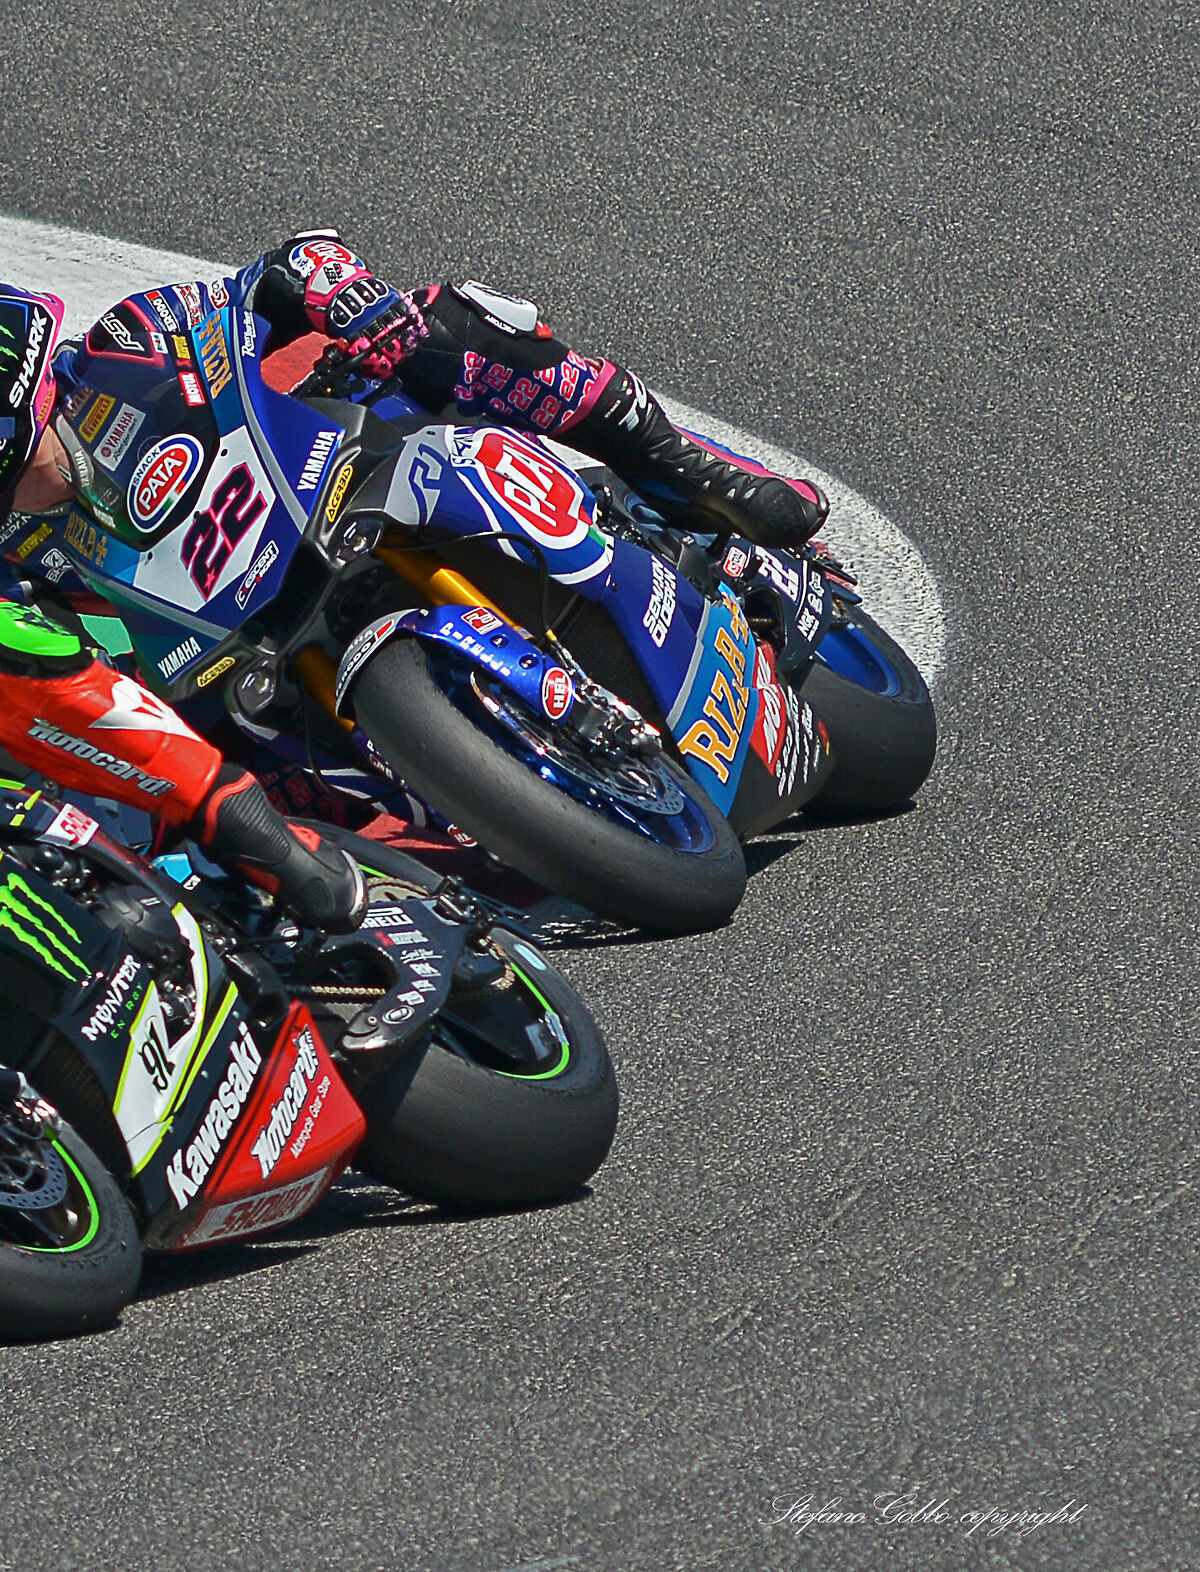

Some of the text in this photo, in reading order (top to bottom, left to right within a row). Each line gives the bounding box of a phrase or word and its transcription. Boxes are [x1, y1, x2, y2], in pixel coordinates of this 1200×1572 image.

[154, 297, 179, 332] ERODO
[9, 307, 48, 408] SHARK
[508, 377, 540, 411] 22
[531, 395, 562, 429] 22
[107, 411, 135, 448] YAMAHA
[133, 447, 161, 487] SNACK
[138, 451, 184, 510] PATA
[298, 430, 338, 491] YAMAHA
[503, 443, 558, 528] PTA
[180, 462, 268, 602] 22
[157, 636, 202, 679] YAMAHA
[553, 675, 567, 709] HEL
[166, 1021, 263, 1211] Kawasaki
